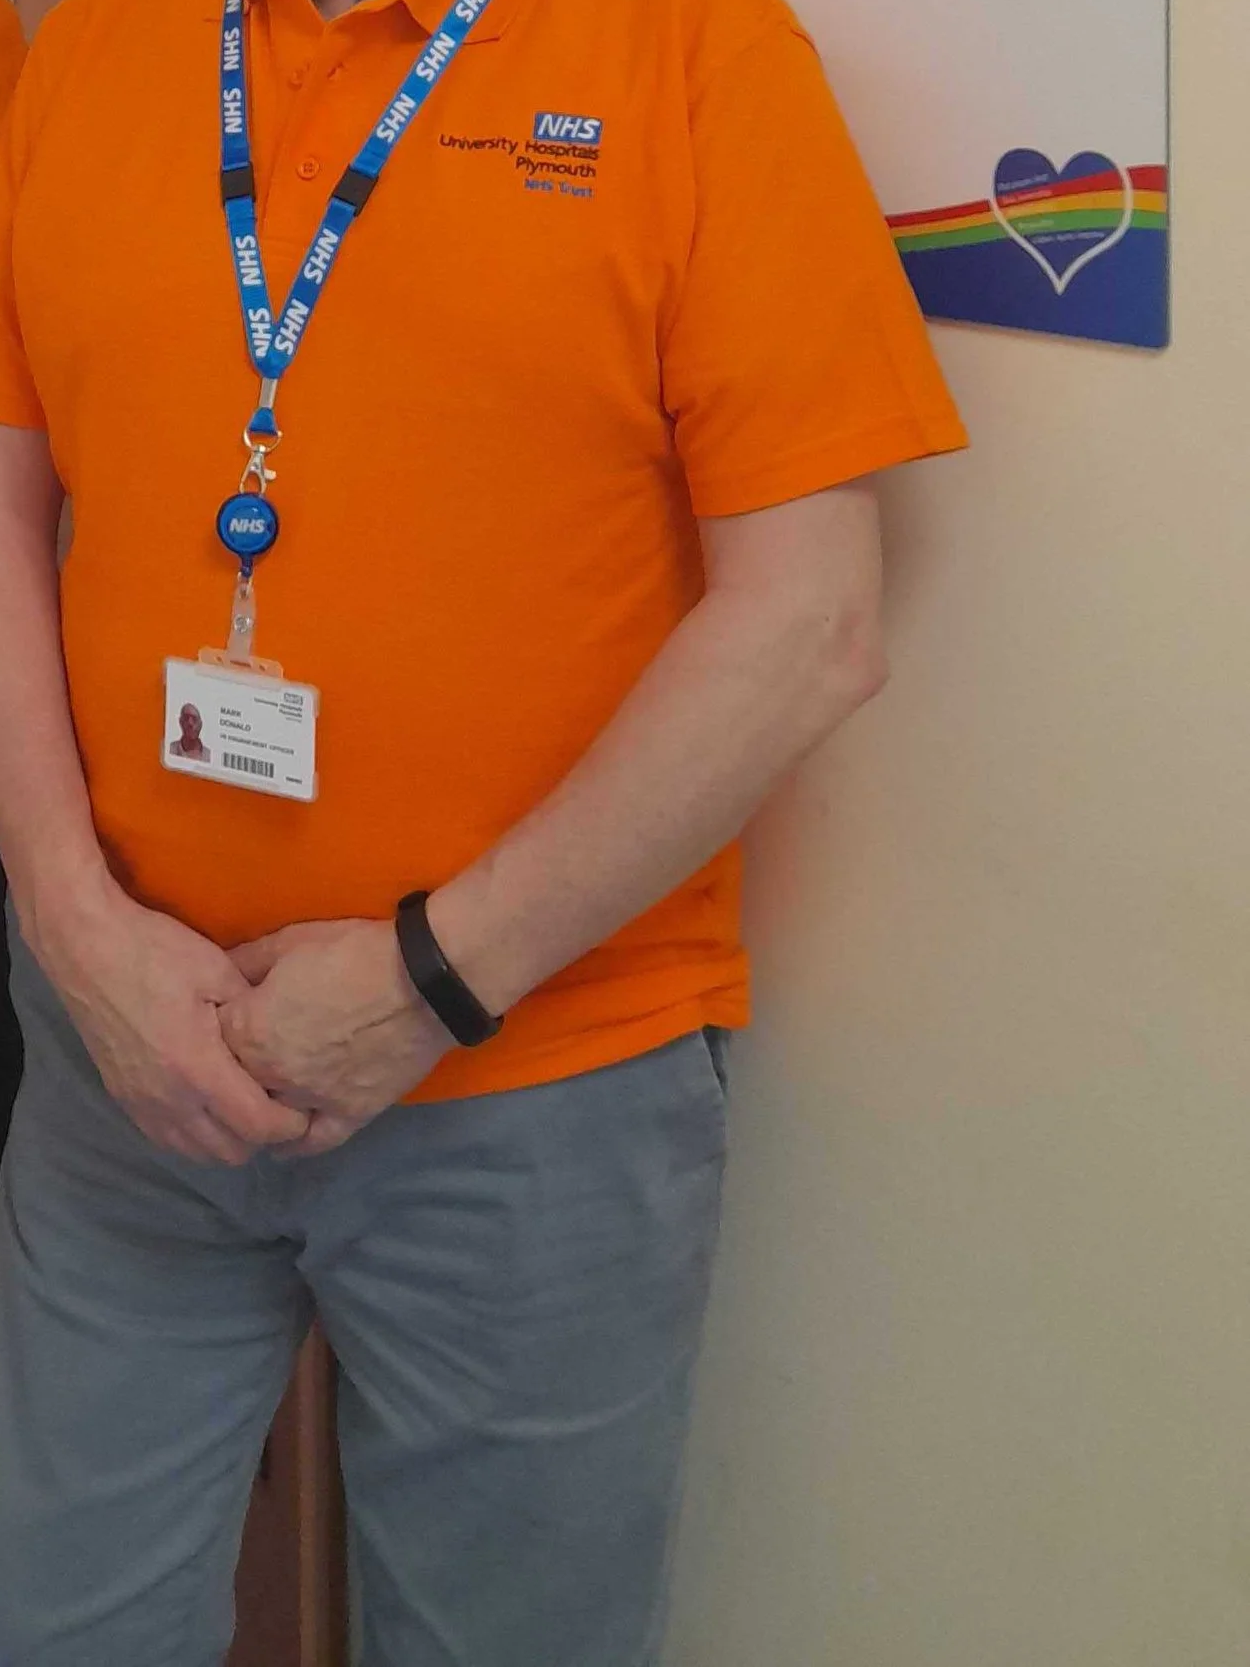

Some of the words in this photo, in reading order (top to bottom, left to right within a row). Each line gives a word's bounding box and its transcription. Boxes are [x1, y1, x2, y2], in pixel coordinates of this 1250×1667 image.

[223, 26, 240, 71] NHS
[415, 31, 457, 82] NHS
[223, 87, 243, 135] NHS
[376, 92, 418, 144] NHS
[536, 113, 601, 140] NHS
[439, 133, 518, 155] University
[525, 140, 599, 161] Hospitals
[515, 156, 597, 177] Plymouth
[235, 234, 262, 286] NHS
[303, 227, 339, 285] NHS
[248, 307, 273, 358] NHS
[274, 298, 310, 355] NHS
[229, 517, 266, 534] NHS
